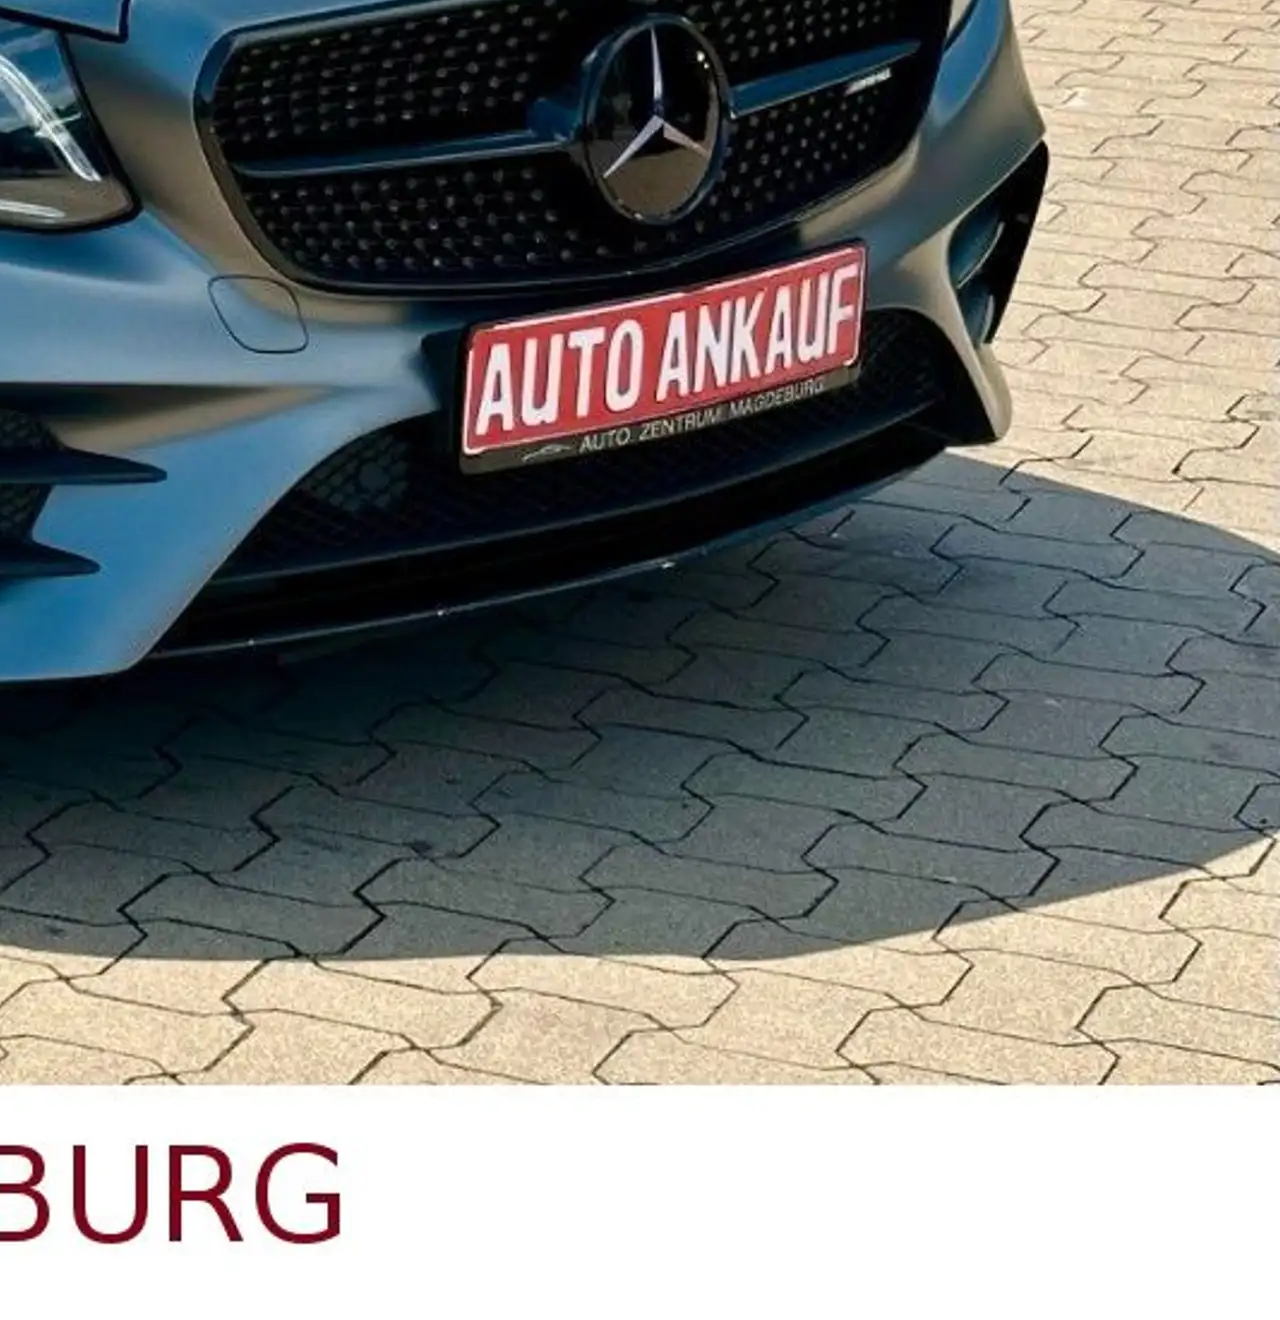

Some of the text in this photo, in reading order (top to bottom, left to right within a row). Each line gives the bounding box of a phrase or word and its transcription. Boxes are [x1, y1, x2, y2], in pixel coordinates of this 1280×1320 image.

[475, 263, 860, 436] AUTO ANKAUF
[578, 378, 826, 454] AUTO ZENTRUM MAGDEBURG
